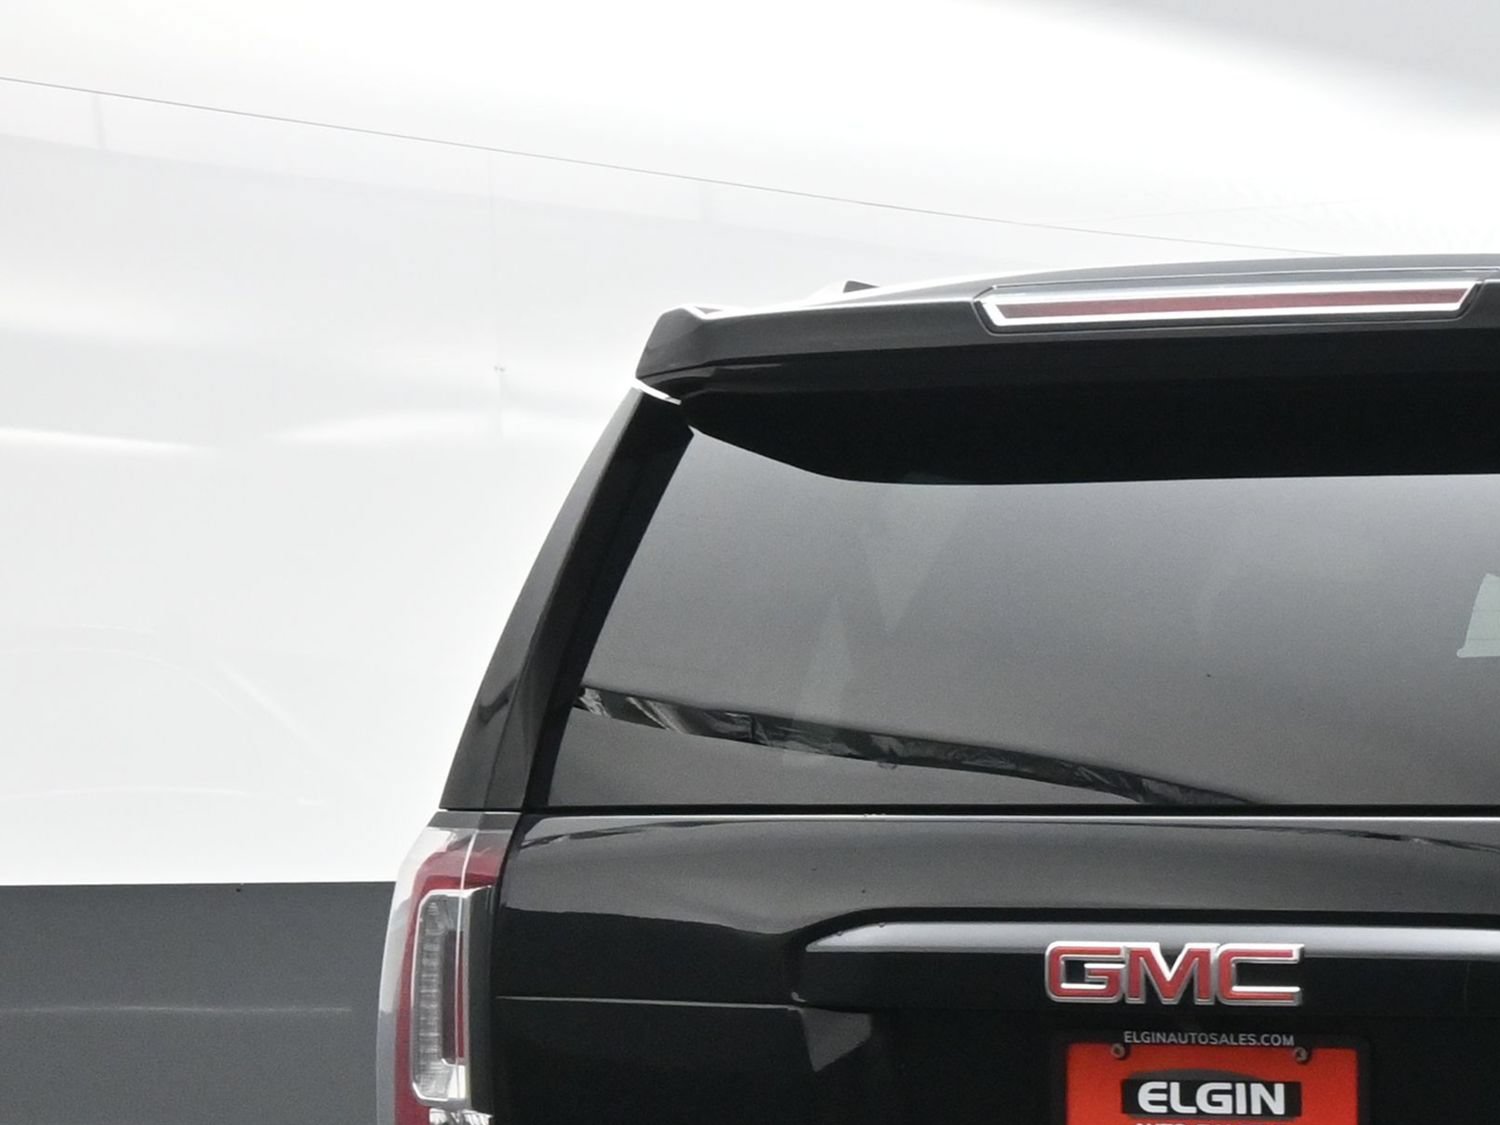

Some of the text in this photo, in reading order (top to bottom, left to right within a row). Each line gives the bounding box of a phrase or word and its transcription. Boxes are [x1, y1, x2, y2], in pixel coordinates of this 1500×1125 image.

[1045, 941, 1305, 1007] GMC
[1124, 1031, 1294, 1046] ELGINAUTOSALES.COM
[1138, 1082, 1285, 1115] ELGIN
